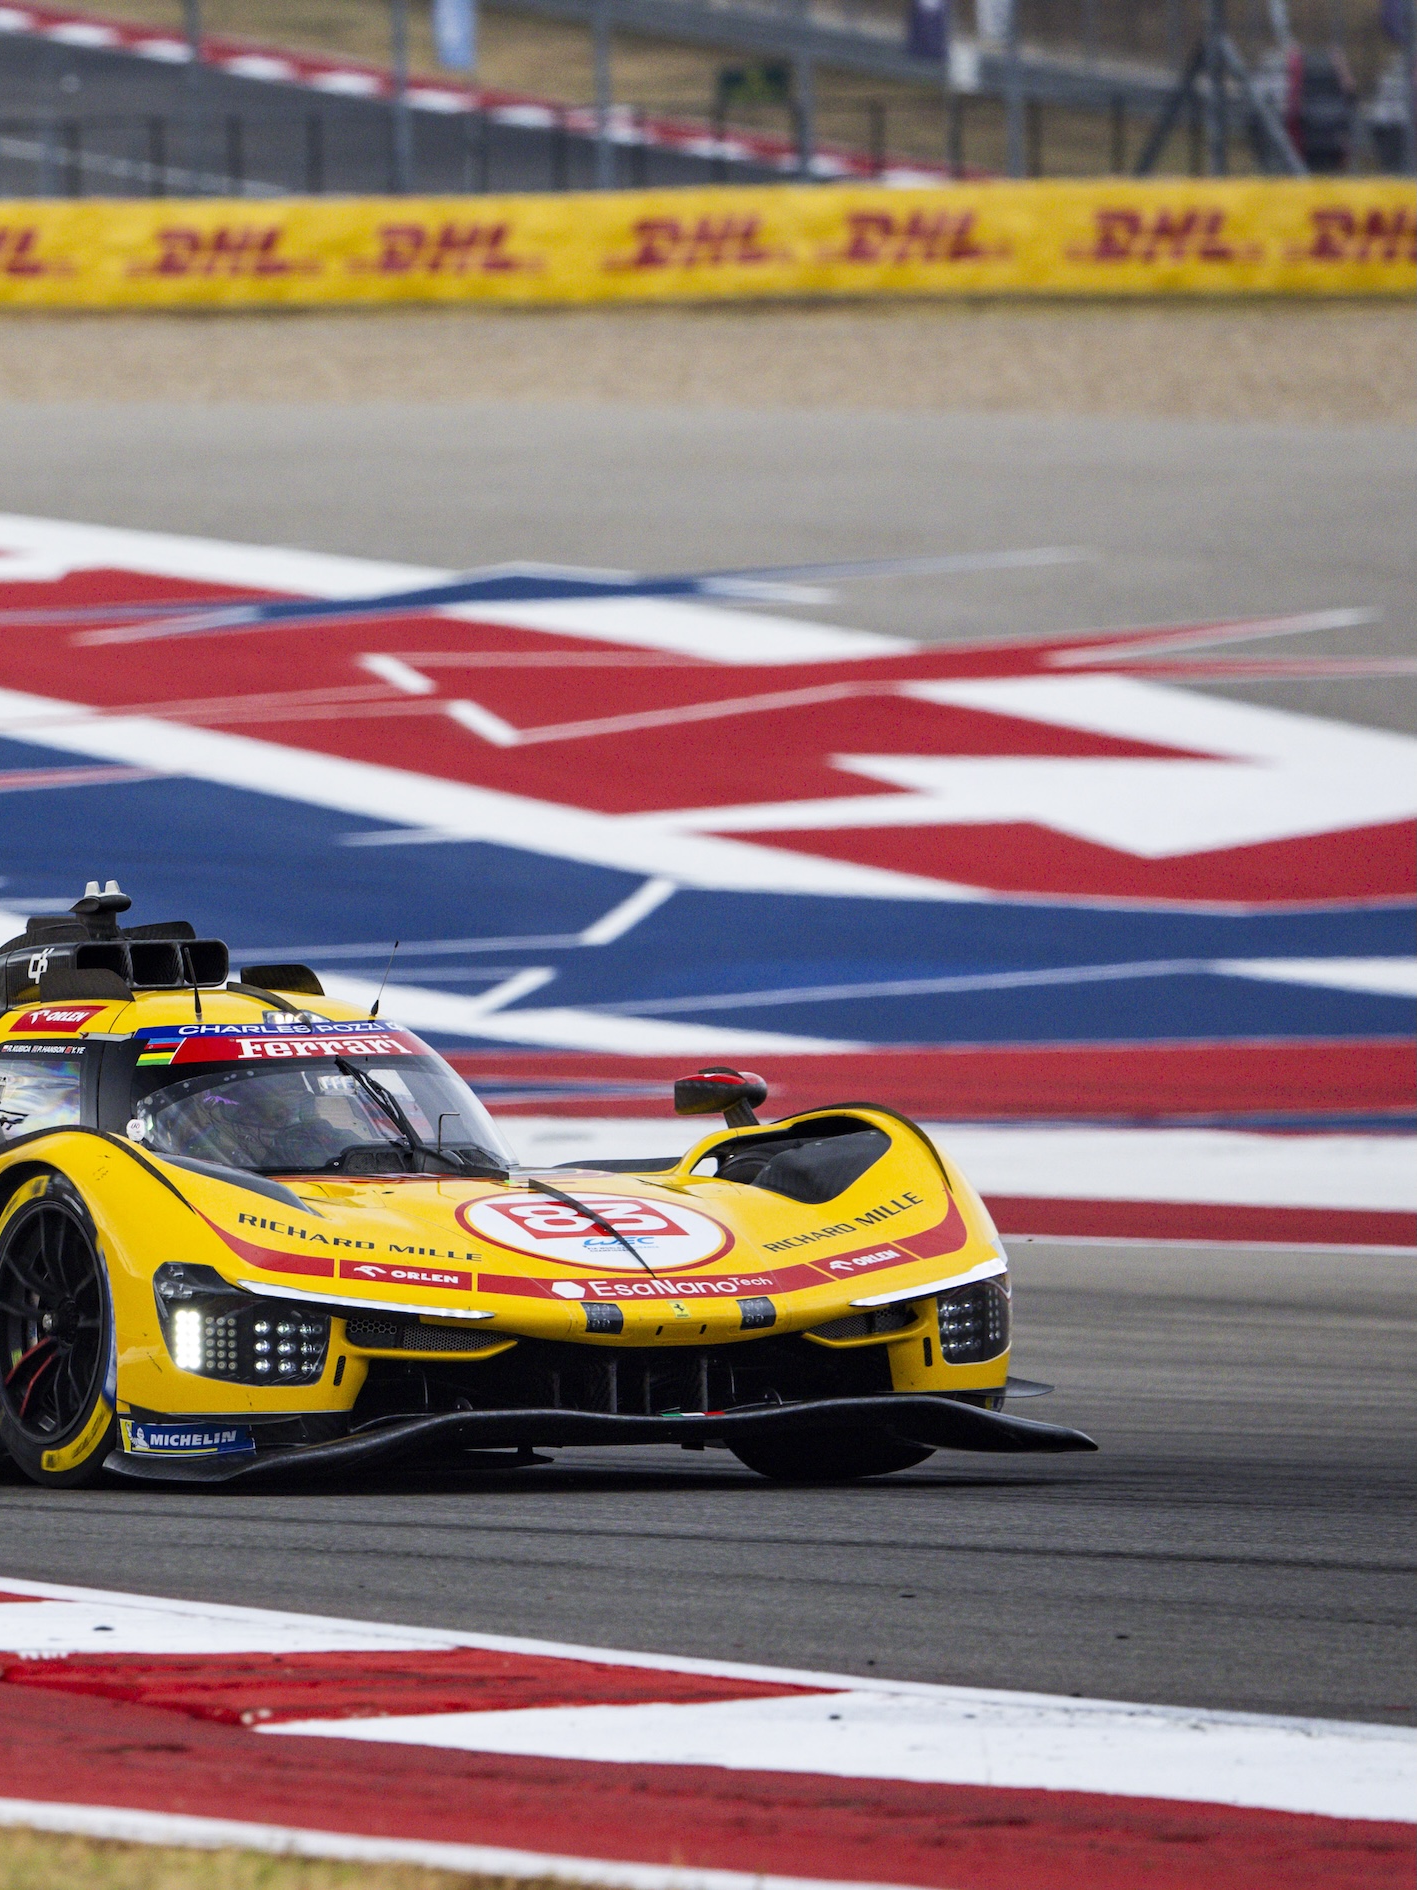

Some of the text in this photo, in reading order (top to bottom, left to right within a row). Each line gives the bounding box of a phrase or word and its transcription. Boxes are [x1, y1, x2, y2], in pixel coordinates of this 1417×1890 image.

[154, 224, 288, 277] DHL
[376, 222, 514, 274] DHL
[632, 212, 767, 269] DHL
[846, 204, 984, 263] DHL
[1092, 209, 1234, 263] DHL
[46, 1011, 90, 1022] ORLEN
[178, 1022, 385, 1036] CHARLES POZZI
[236, 1034, 413, 1060] Ferrari
[238, 1213, 483, 1262] RICHARD MILLE
[508, 1202, 668, 1233] 83
[762, 1191, 924, 1253] RICHARD MILLE
[390, 1270, 459, 1284] ORLEN
[852, 1249, 901, 1267] ORLEN
[150, 1430, 237, 1447] MICHELIN
